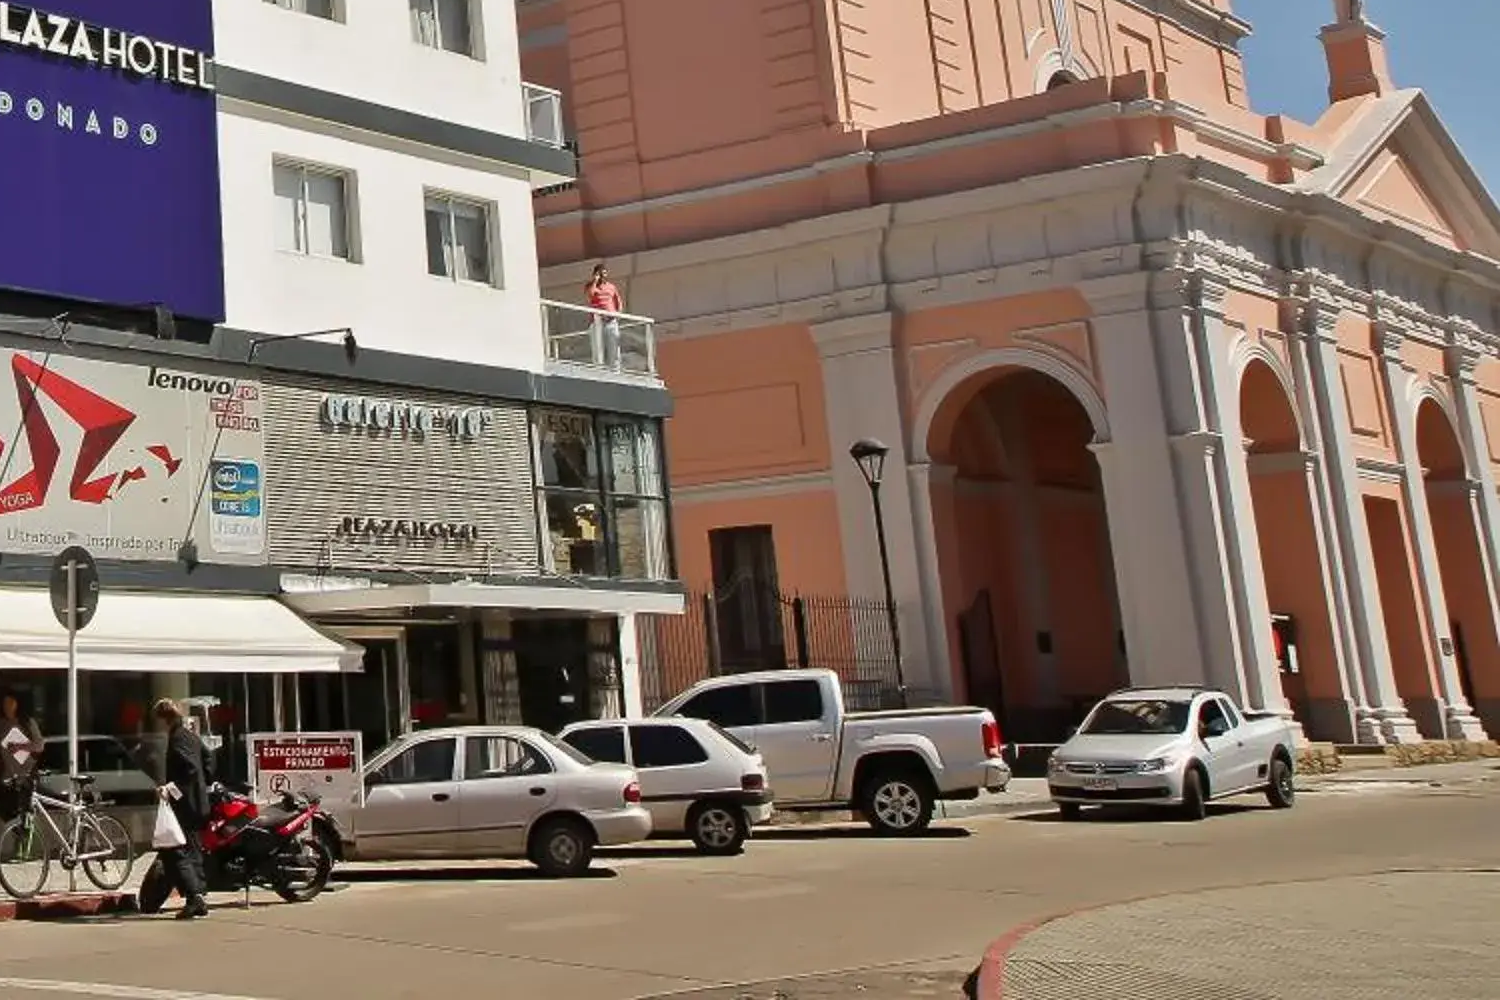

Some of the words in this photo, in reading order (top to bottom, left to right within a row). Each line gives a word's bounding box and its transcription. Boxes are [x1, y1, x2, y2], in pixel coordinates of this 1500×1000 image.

[104, 28, 215, 89] HOTEL
[148, 366, 231, 395] lenovo
[0, 491, 35, 508] YOGA
[263, 746, 349, 757] ESTACIONAMIENTO
[285, 757, 325, 769] PRIVADO
